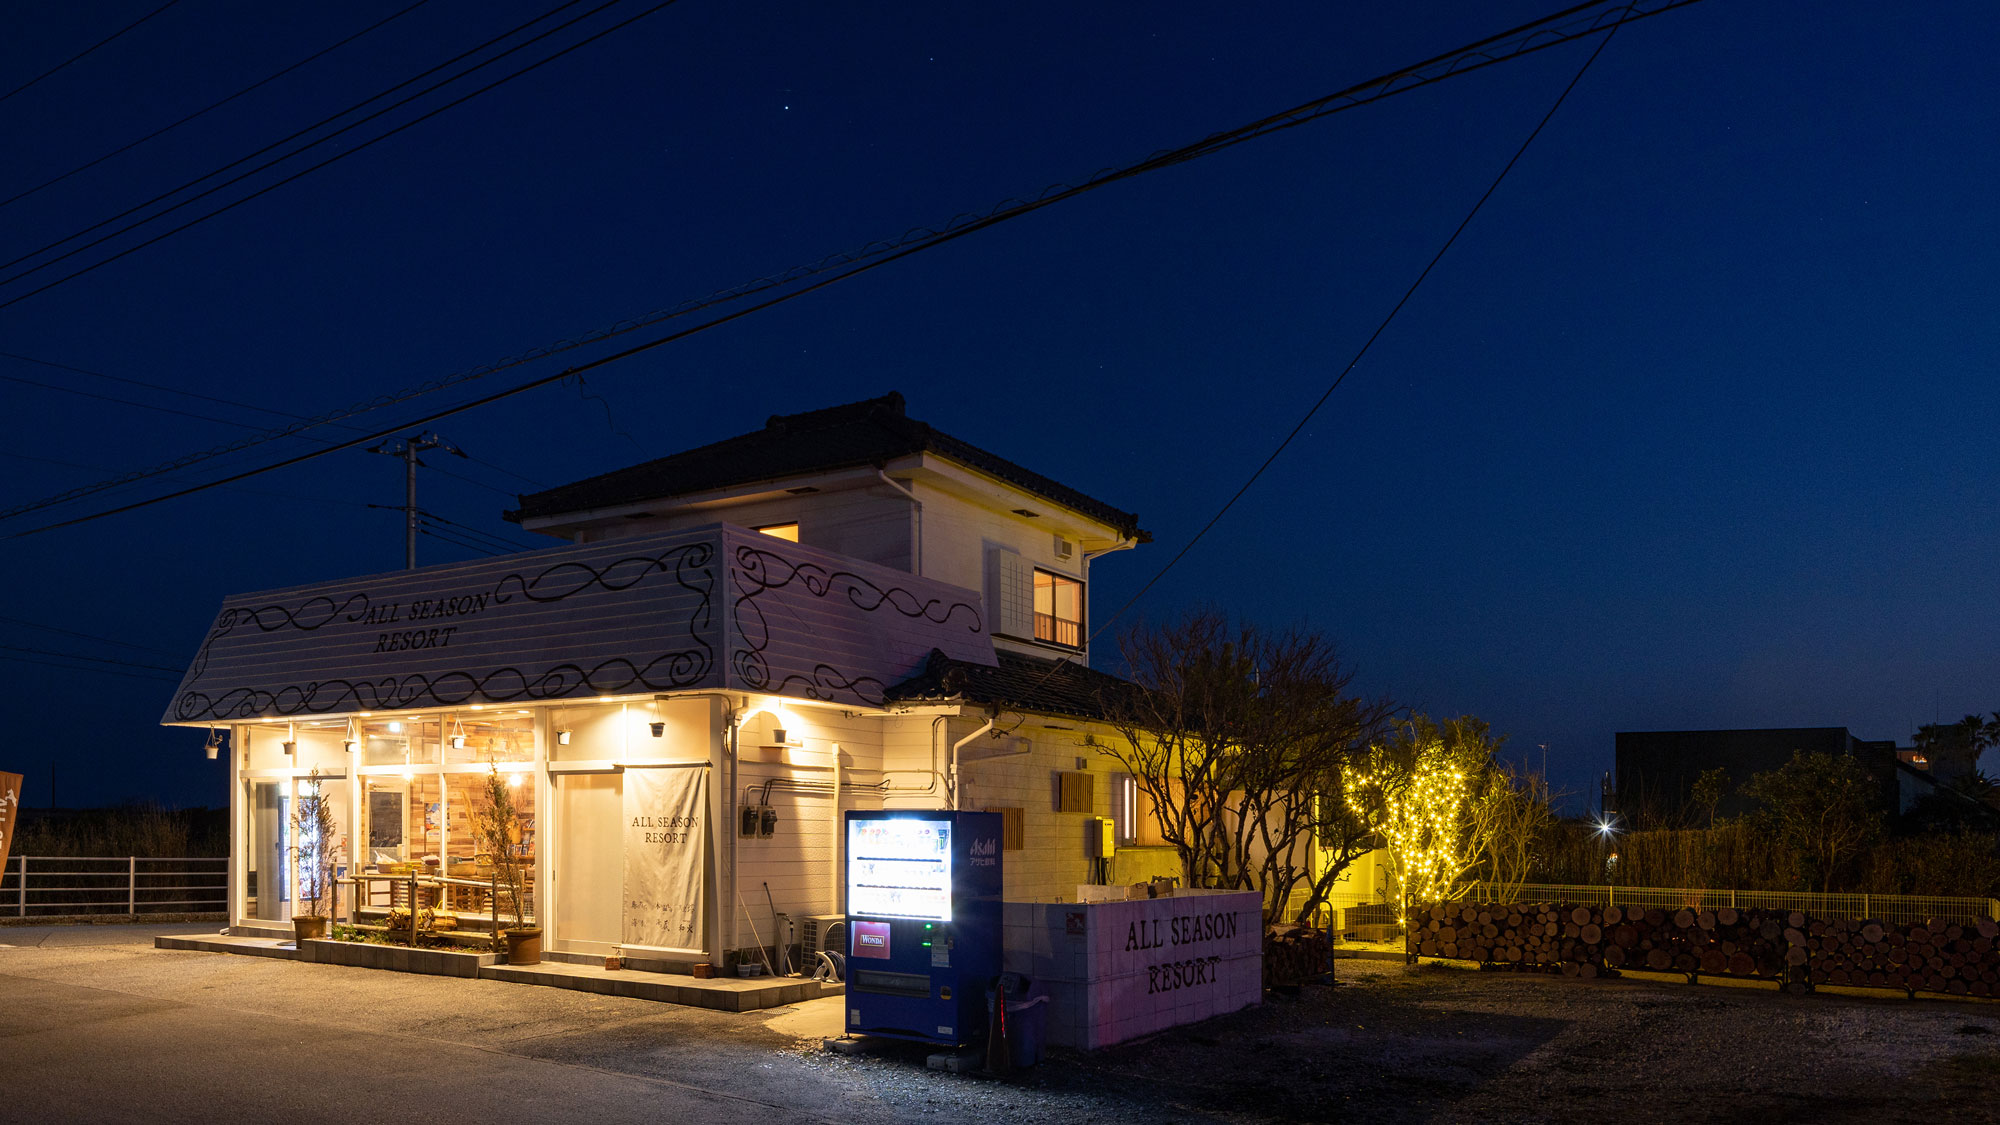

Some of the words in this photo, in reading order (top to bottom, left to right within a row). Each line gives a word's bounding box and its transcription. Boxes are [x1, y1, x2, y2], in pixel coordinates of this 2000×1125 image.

[363, 603, 400, 625] ALL
[408, 592, 491, 621] SEASON
[373, 626, 457, 653] RESORT
[632, 817, 654, 828] ALL
[657, 816, 699, 828] SEASON
[645, 832, 688, 844] RESORT
[1125, 919, 1163, 951] ALL
[1171, 911, 1238, 946] SEASON
[1147, 955, 1222, 994] RESORT
